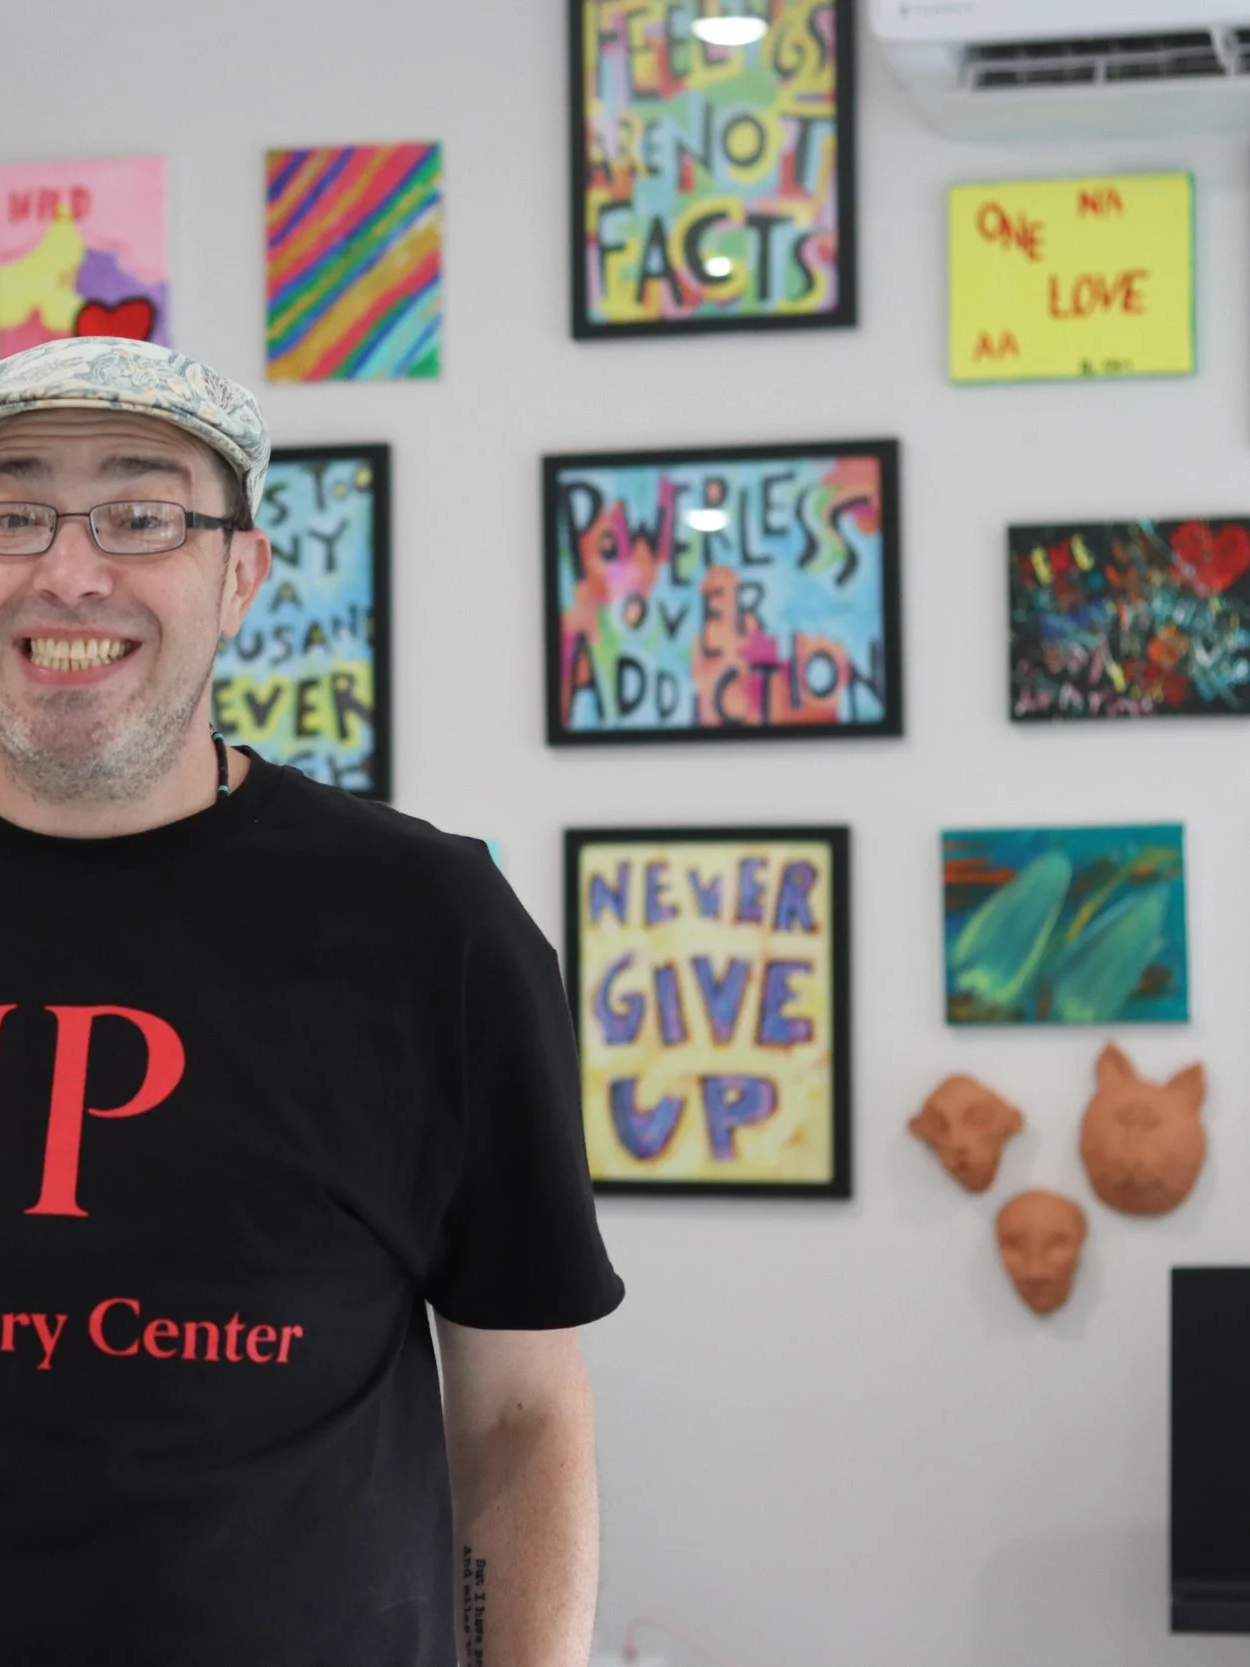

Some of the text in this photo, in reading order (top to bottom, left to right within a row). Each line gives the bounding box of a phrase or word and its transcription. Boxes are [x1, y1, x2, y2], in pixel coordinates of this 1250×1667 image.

[676, 101, 837, 191] NOT
[598, 202, 820, 306] FACTS
[975, 200, 1046, 263] ONE
[1047, 267, 1152, 320] LOVE
[972, 330, 1021, 364] AA
[264, 480, 291, 528] S
[559, 471, 873, 585] POWERLESS
[268, 581, 303, 613] A
[623, 581, 765, 658] OVER
[212, 670, 373, 742] EVER
[565, 629, 885, 724] ADDICTION
[587, 856, 821, 933] NEVER
[591, 950, 816, 1052] GIVE
[608, 1074, 778, 1162] UP
[89, 1297, 303, 1363] Center
